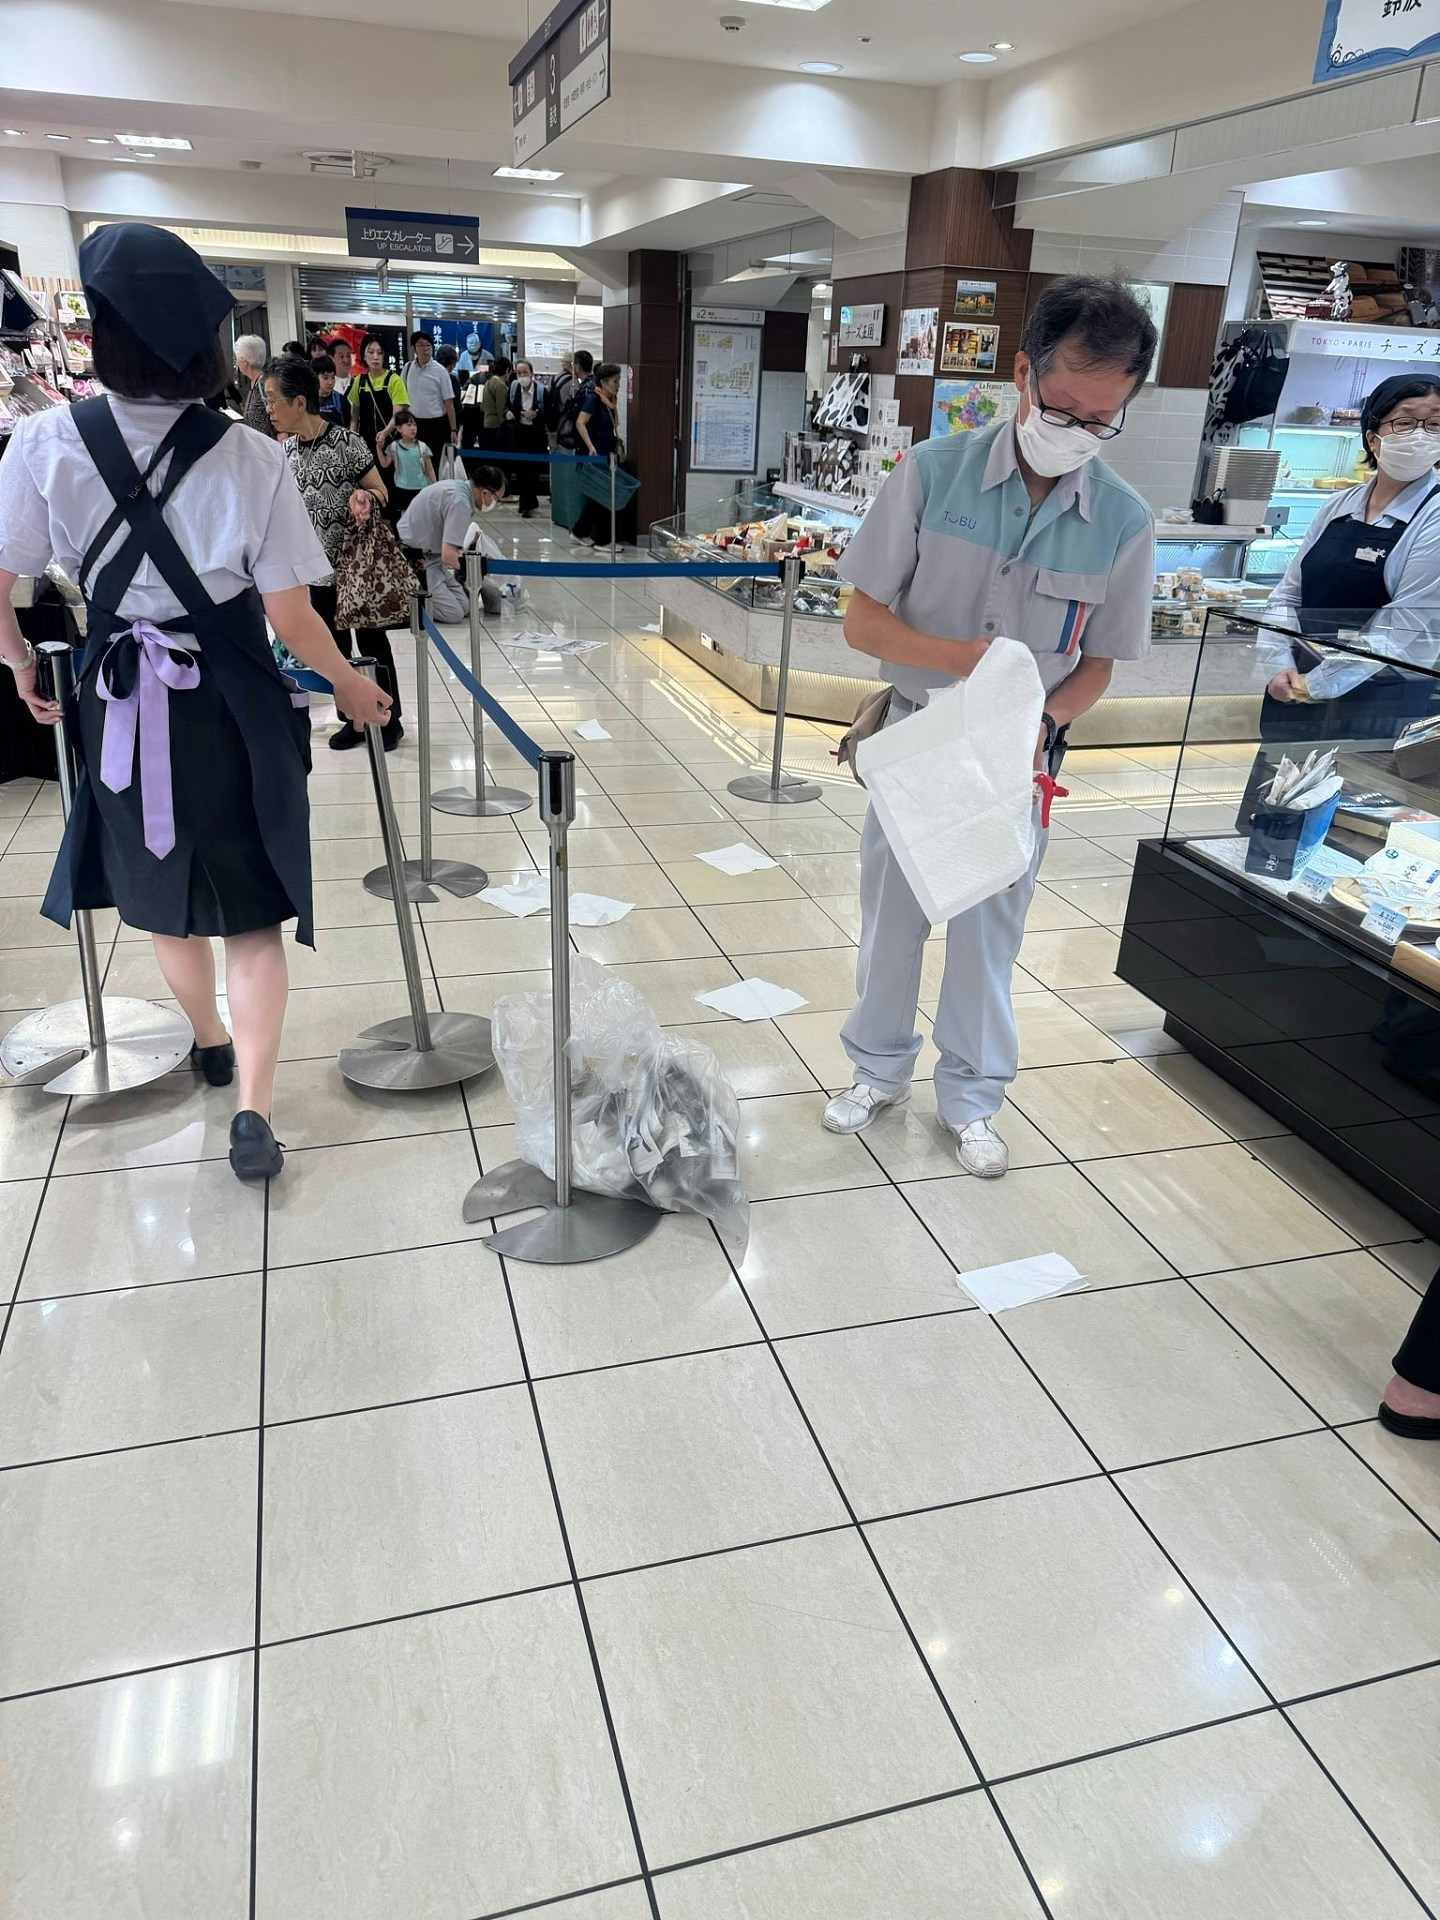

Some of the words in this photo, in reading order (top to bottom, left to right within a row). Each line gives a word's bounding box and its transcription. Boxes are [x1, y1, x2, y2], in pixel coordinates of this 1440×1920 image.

[549, 53, 556, 96] 3
[361, 227, 432, 244] 上りエスカレーター
[376, 242, 388, 250] UP
[389, 243, 433, 253] ESCALATOR
[944, 510, 977, 530] TOBU
